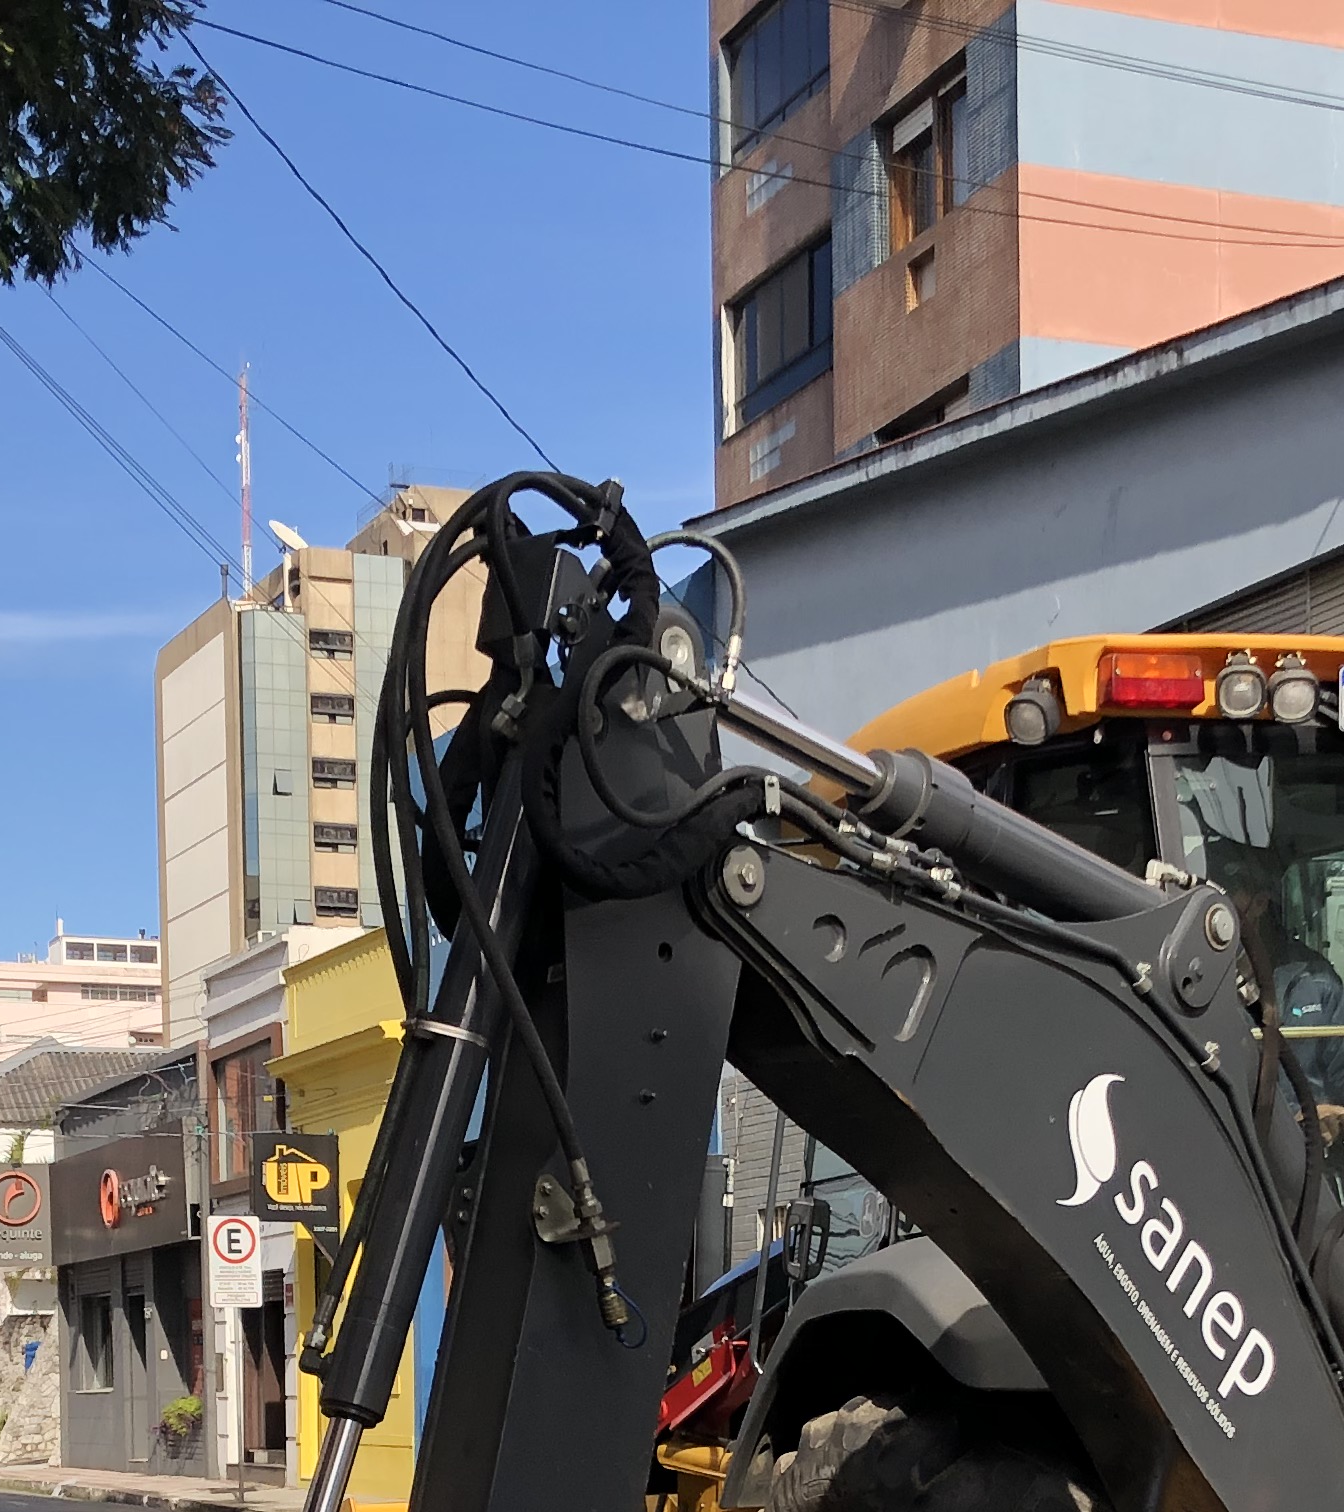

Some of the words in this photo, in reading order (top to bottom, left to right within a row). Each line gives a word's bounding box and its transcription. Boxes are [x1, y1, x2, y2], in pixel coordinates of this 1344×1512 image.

[265, 1161, 331, 1204] UP
[19, 1250, 44, 1261] aluga
[226, 1228, 242, 1254] E
[1113, 1159, 1276, 1400] sanep
